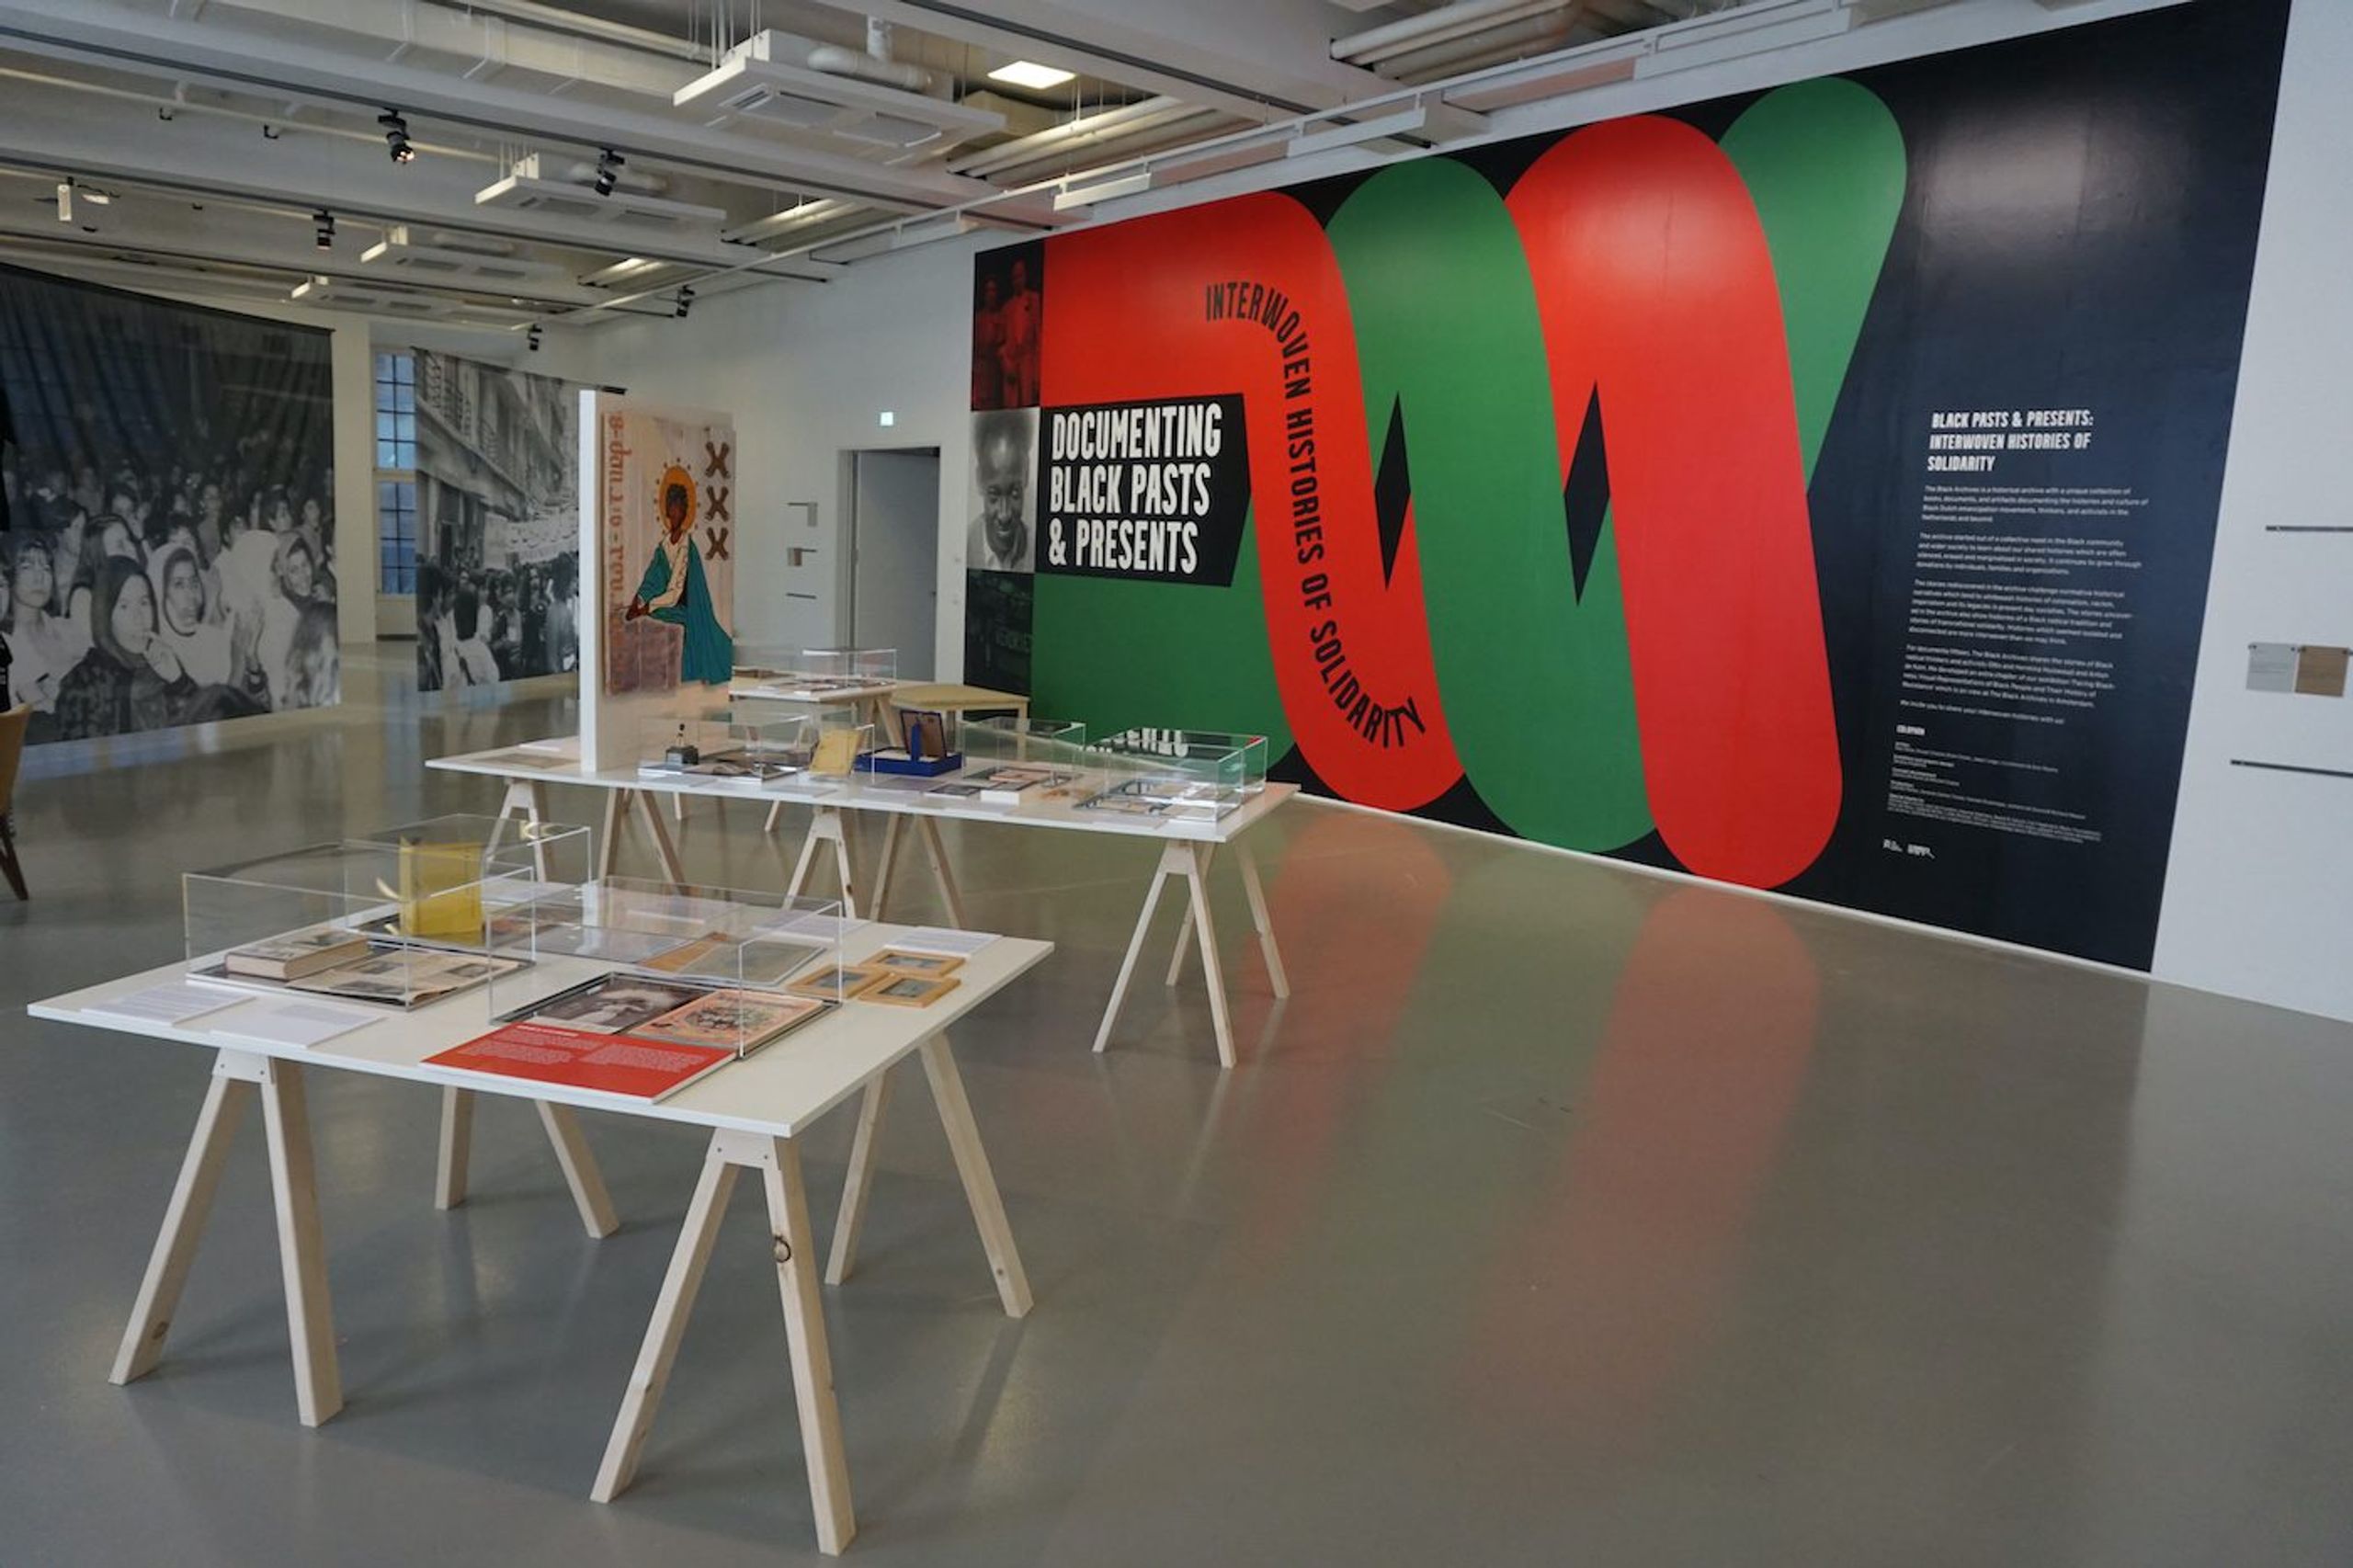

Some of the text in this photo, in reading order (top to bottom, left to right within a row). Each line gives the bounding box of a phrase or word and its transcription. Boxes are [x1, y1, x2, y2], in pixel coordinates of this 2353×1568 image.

[1051, 403, 1222, 460] DOCUMENTING
[1929, 432, 2092, 449] INTERWOVEN HISTORIES OF
[1932, 410, 2094, 428] BLACK PASTS & PRESENTS:
[1050, 462, 1211, 517] BLACK PASTS
[1927, 455, 1995, 472] SOLIDARITY
[1206, 282, 1426, 748] INTERWOVEN HISTORIES OF SOLIDARITY
[1048, 517, 1199, 574] & PRESENTS
